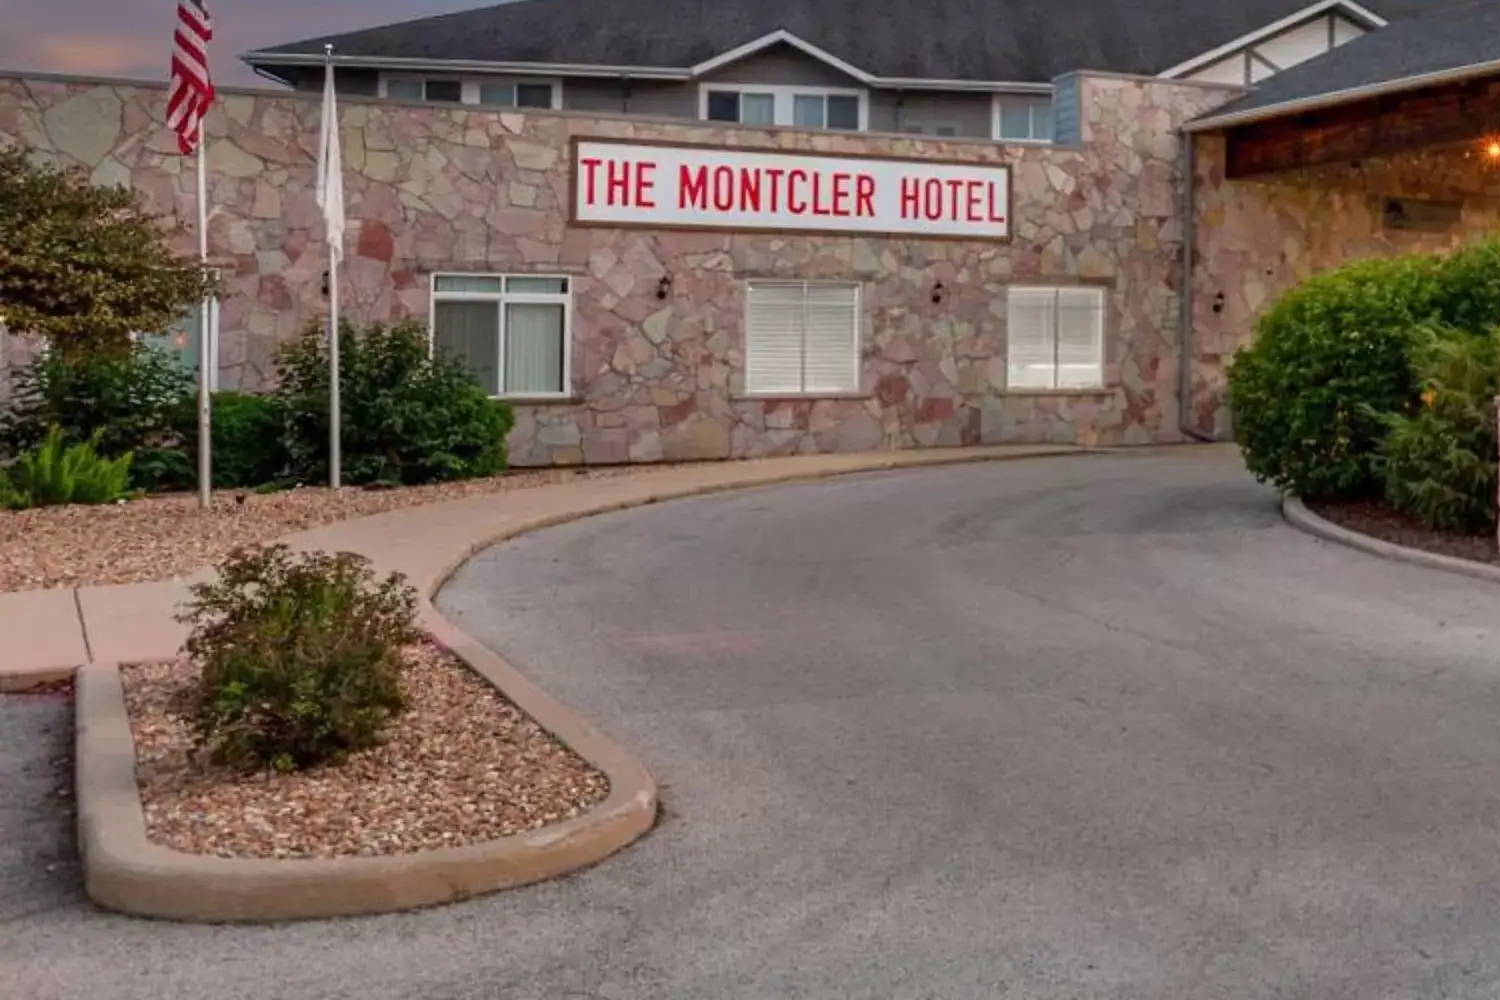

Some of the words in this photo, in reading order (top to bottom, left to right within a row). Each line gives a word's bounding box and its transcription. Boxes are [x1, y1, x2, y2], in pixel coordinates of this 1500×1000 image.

[581, 158, 656, 209] THE
[678, 163, 876, 217] MONTCLER
[899, 177, 1004, 223] HOTEL
